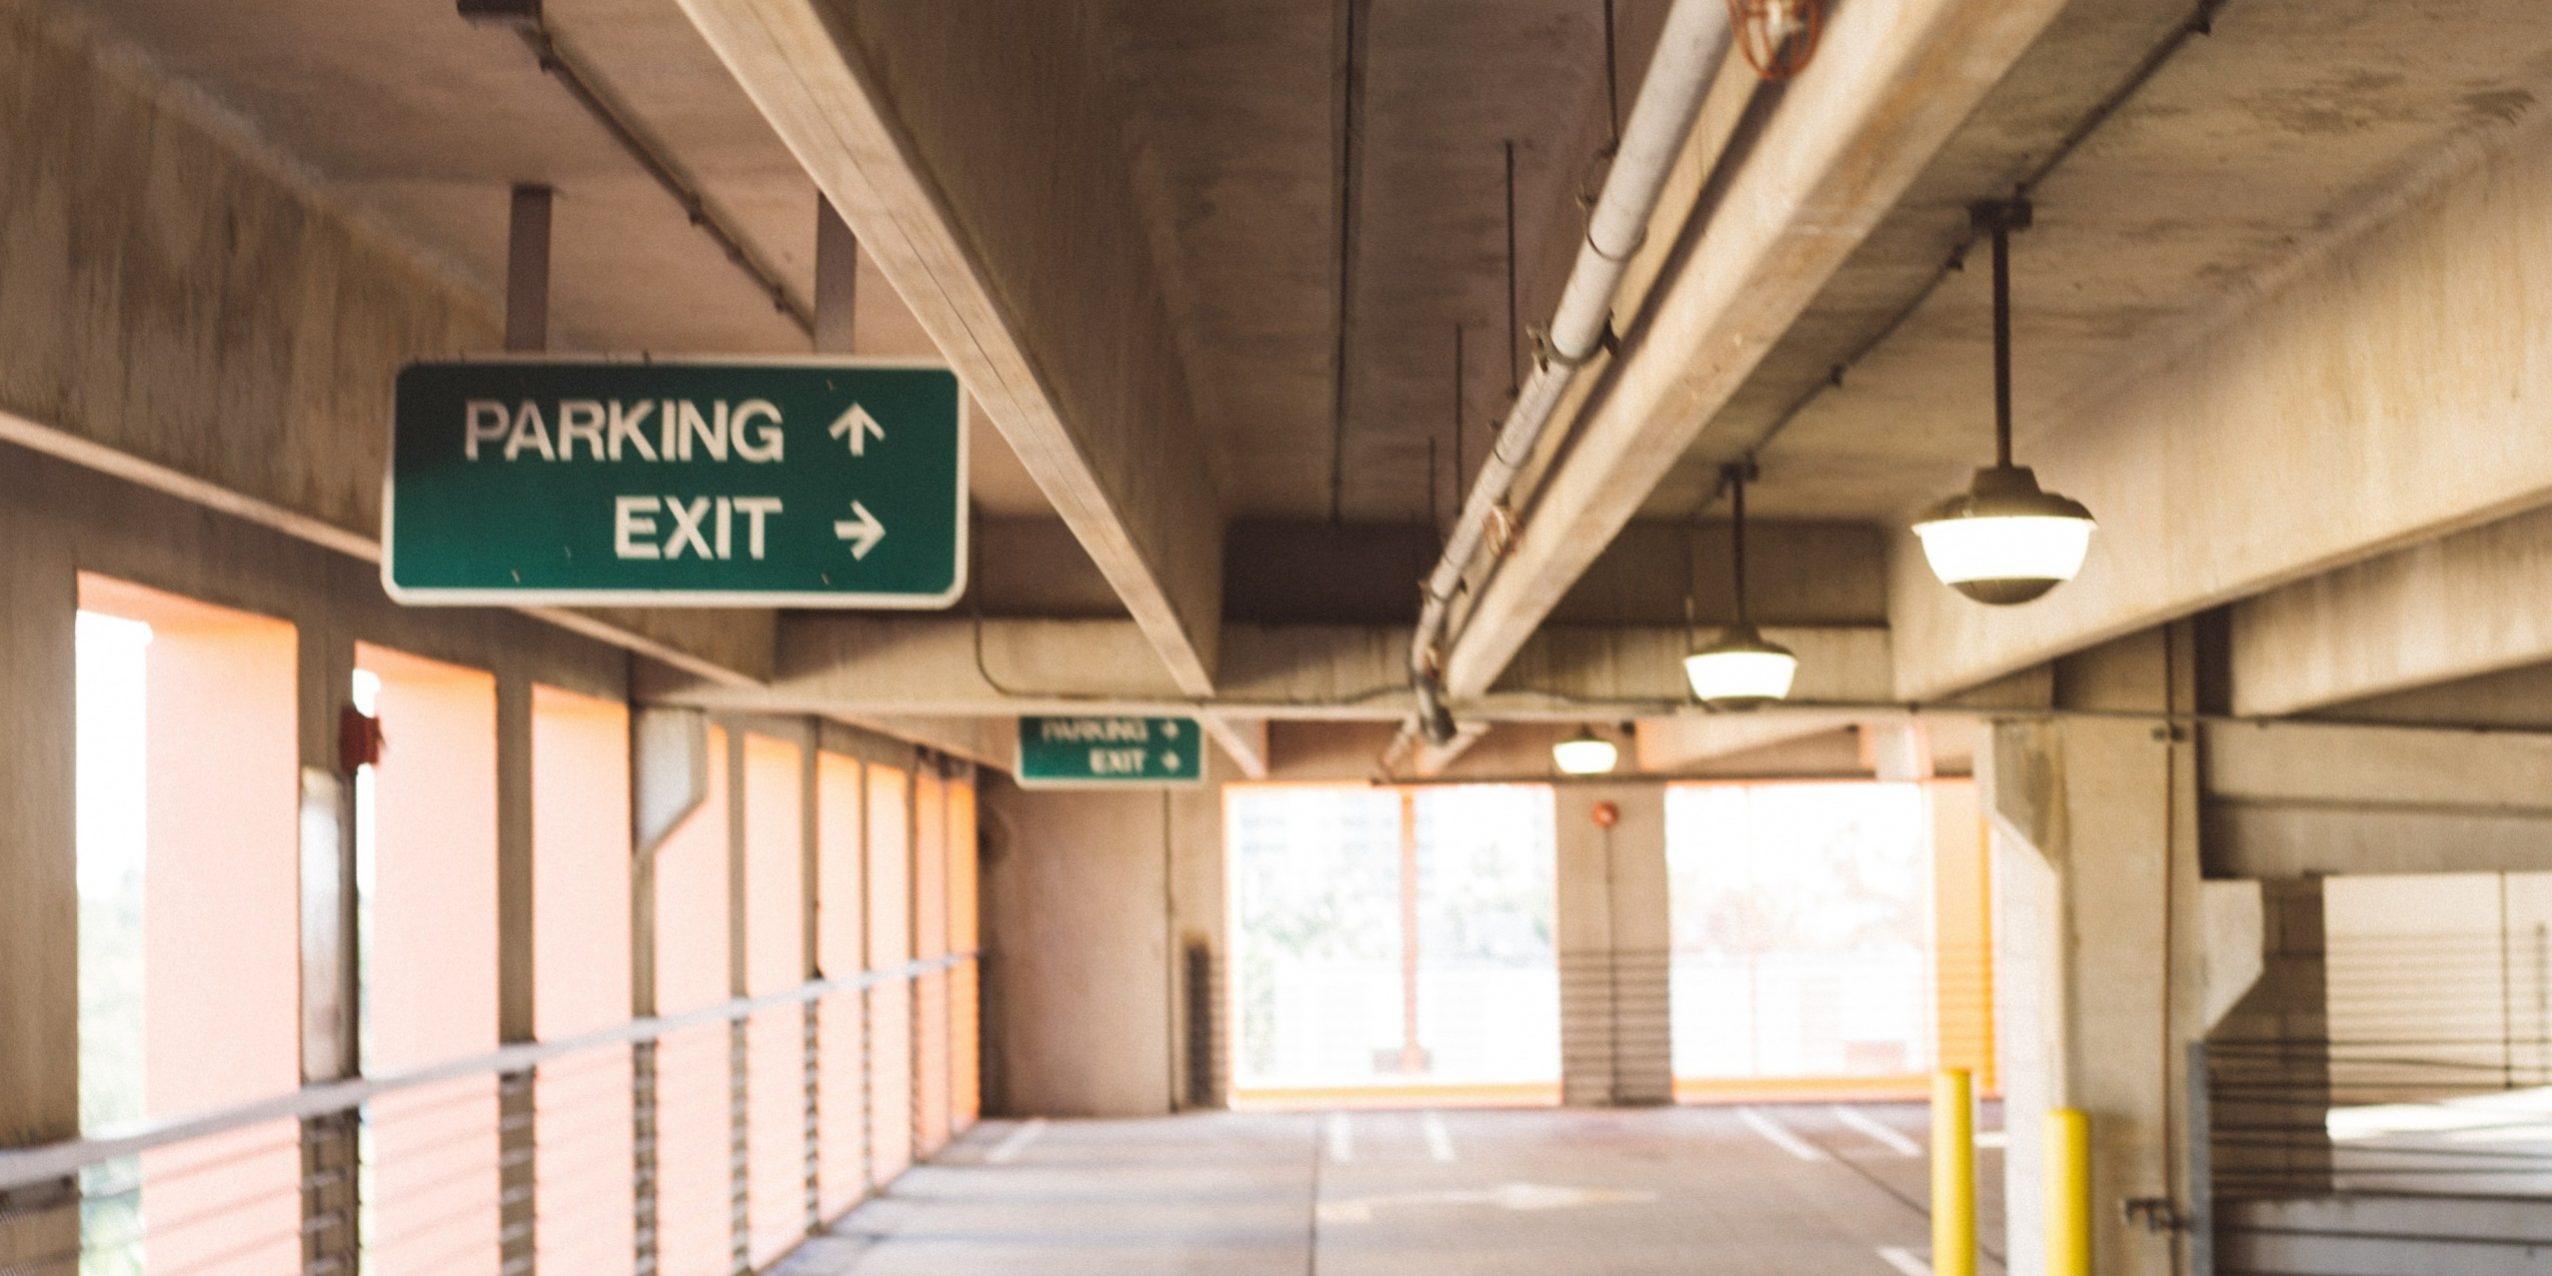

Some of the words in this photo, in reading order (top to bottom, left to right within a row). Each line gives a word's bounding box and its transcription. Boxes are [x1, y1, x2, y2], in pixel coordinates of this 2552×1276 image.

[465, 399, 784, 463] PARKING
[615, 496, 784, 560] EXIT
[1090, 748, 1146, 774] EXIT
